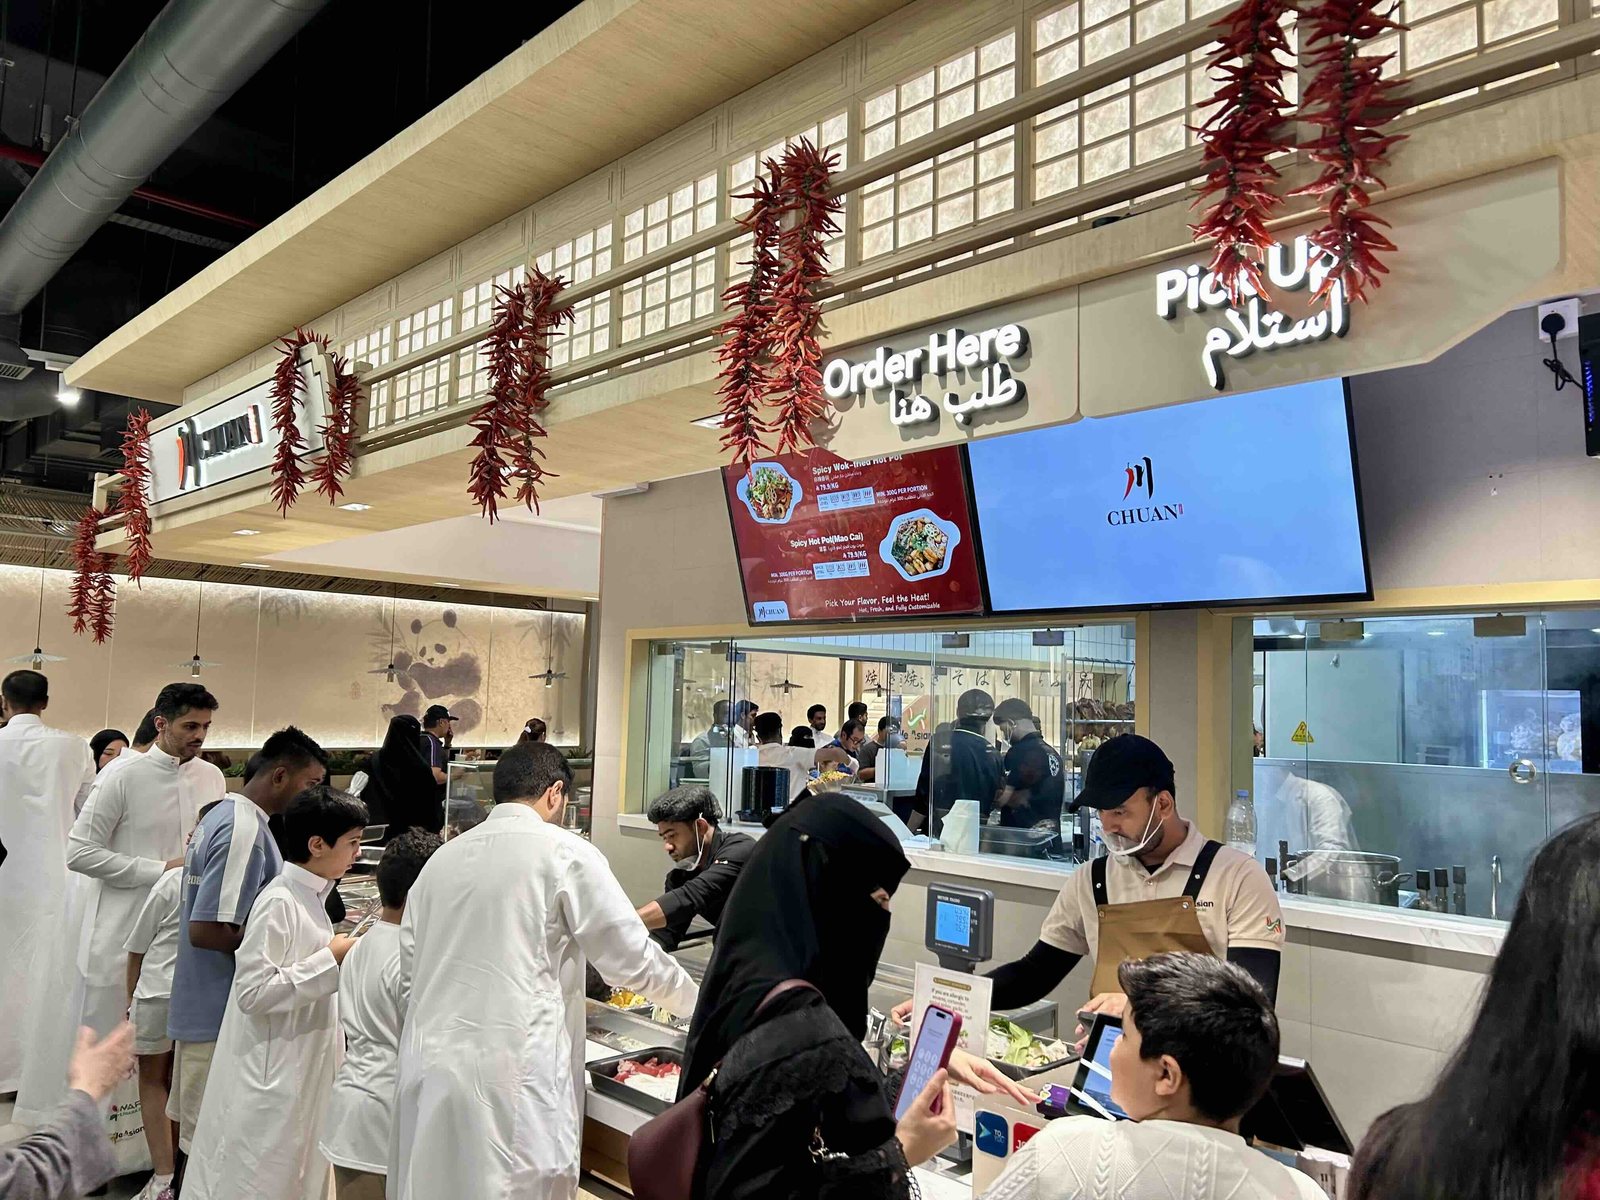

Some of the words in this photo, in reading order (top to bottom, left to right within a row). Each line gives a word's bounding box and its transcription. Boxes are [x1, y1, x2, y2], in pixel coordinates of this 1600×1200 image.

[1201, 278, 1344, 389] استلام
[823, 346, 923, 398] Order
[929, 324, 1021, 374] Here
[943, 362, 1018, 425] طلب
[889, 383, 932, 425] هنا
[812, 465, 832, 475] Spicy
[898, 487, 907, 495] PER
[907, 485, 928, 493] PORTION
[1107, 504, 1178, 526] CHUAN
[790, 539, 807, 548] Spicy
[808, 537, 820, 546] Hot
[849, 532, 864, 542] Cai)
[825, 599, 839, 607] Pick
[840, 598, 855, 606] Your
[857, 596, 880, 606] Flavor,
[881, 594, 895, 604] Feel
[897, 594, 908, 603] the
[910, 593, 930, 602] Heat!
[895, 604, 908, 612] Fully
[908, 602, 941, 610] Customizable
[1194, 900, 1214, 908] sian
